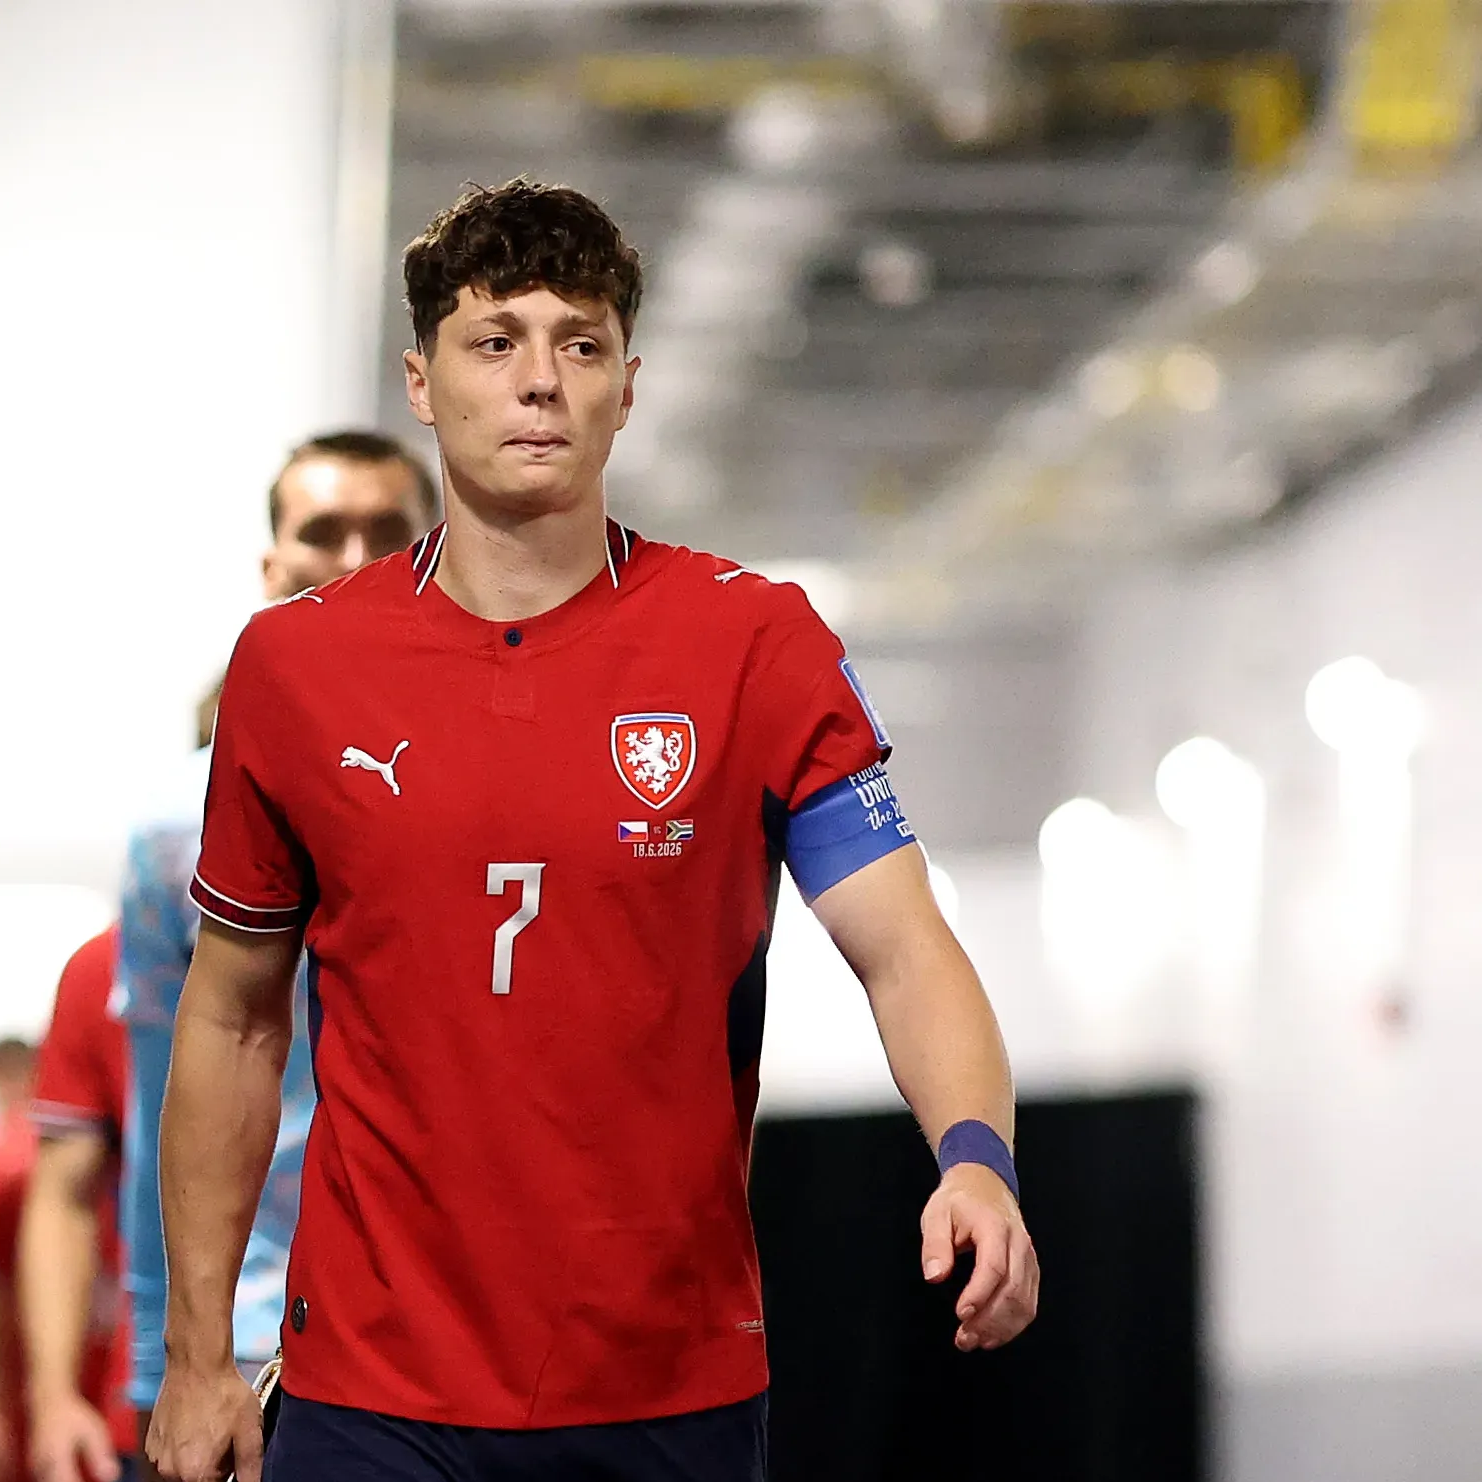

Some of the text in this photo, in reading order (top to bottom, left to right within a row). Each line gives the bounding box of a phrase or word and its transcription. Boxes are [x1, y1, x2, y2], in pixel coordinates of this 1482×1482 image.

[865, 807, 893, 831] the
[633, 842, 682, 857] 18.6.2026
[487, 863, 546, 994] 7
